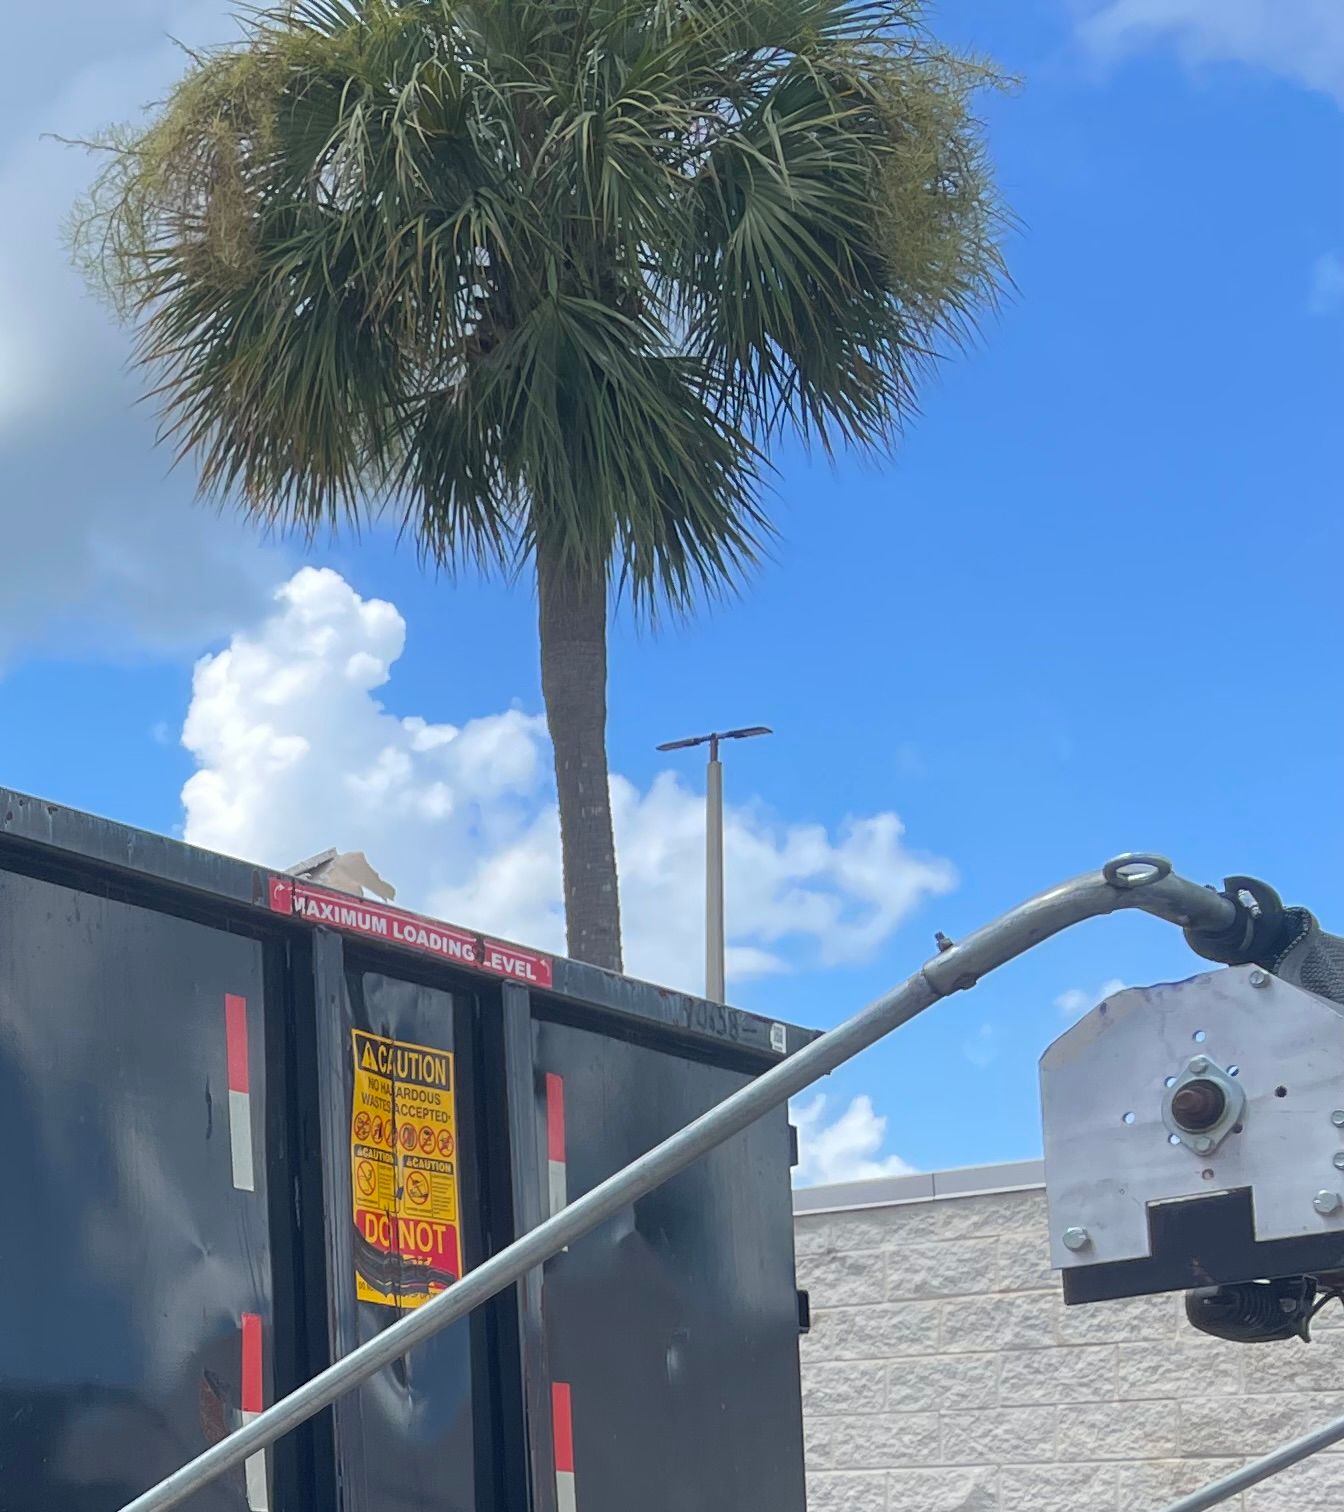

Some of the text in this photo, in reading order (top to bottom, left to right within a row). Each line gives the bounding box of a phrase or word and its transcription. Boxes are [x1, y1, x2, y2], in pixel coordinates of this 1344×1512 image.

[293, 895, 387, 936] MAXIMUM
[393, 921, 475, 962] LOADING
[377, 1044, 447, 1086] CAUTION
[368, 1077, 380, 1091] NO
[361, 1092, 391, 1114] WASTES
[412, 1157, 452, 1173] CAUTION
[365, 1213, 447, 1254] DO NOT
